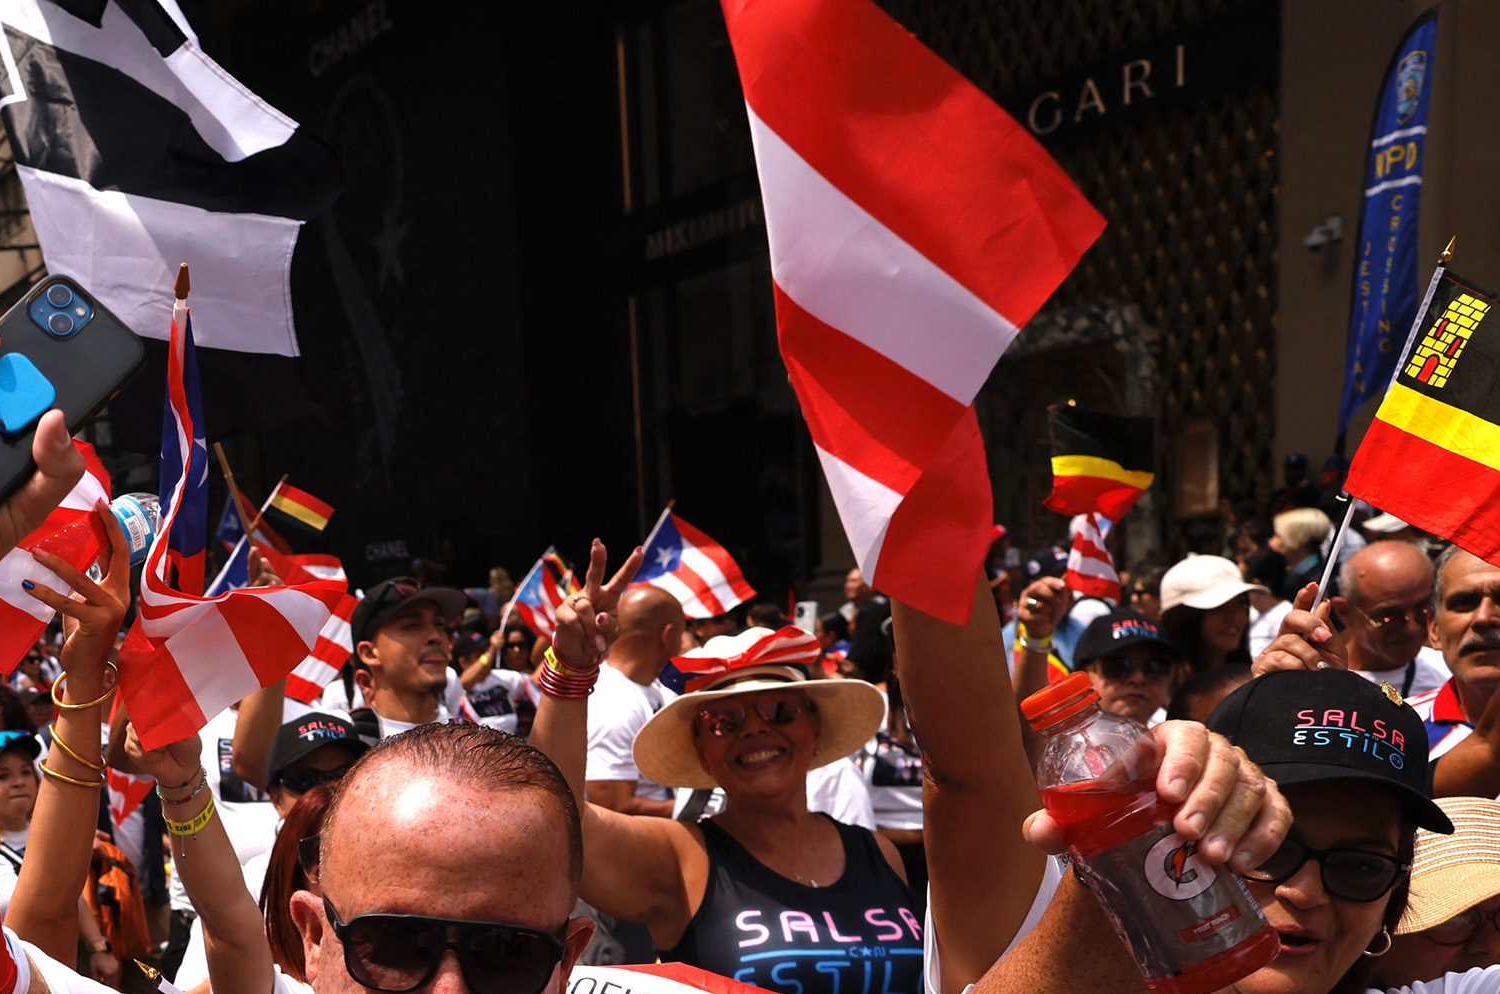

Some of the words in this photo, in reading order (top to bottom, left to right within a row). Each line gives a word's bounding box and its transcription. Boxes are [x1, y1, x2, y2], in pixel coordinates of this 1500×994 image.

[308, 0, 394, 78] CHANEL
[298, 721, 347, 735] SALSA
[1297, 709, 1405, 752] SALSA
[1293, 731, 1404, 770] ESTILO
